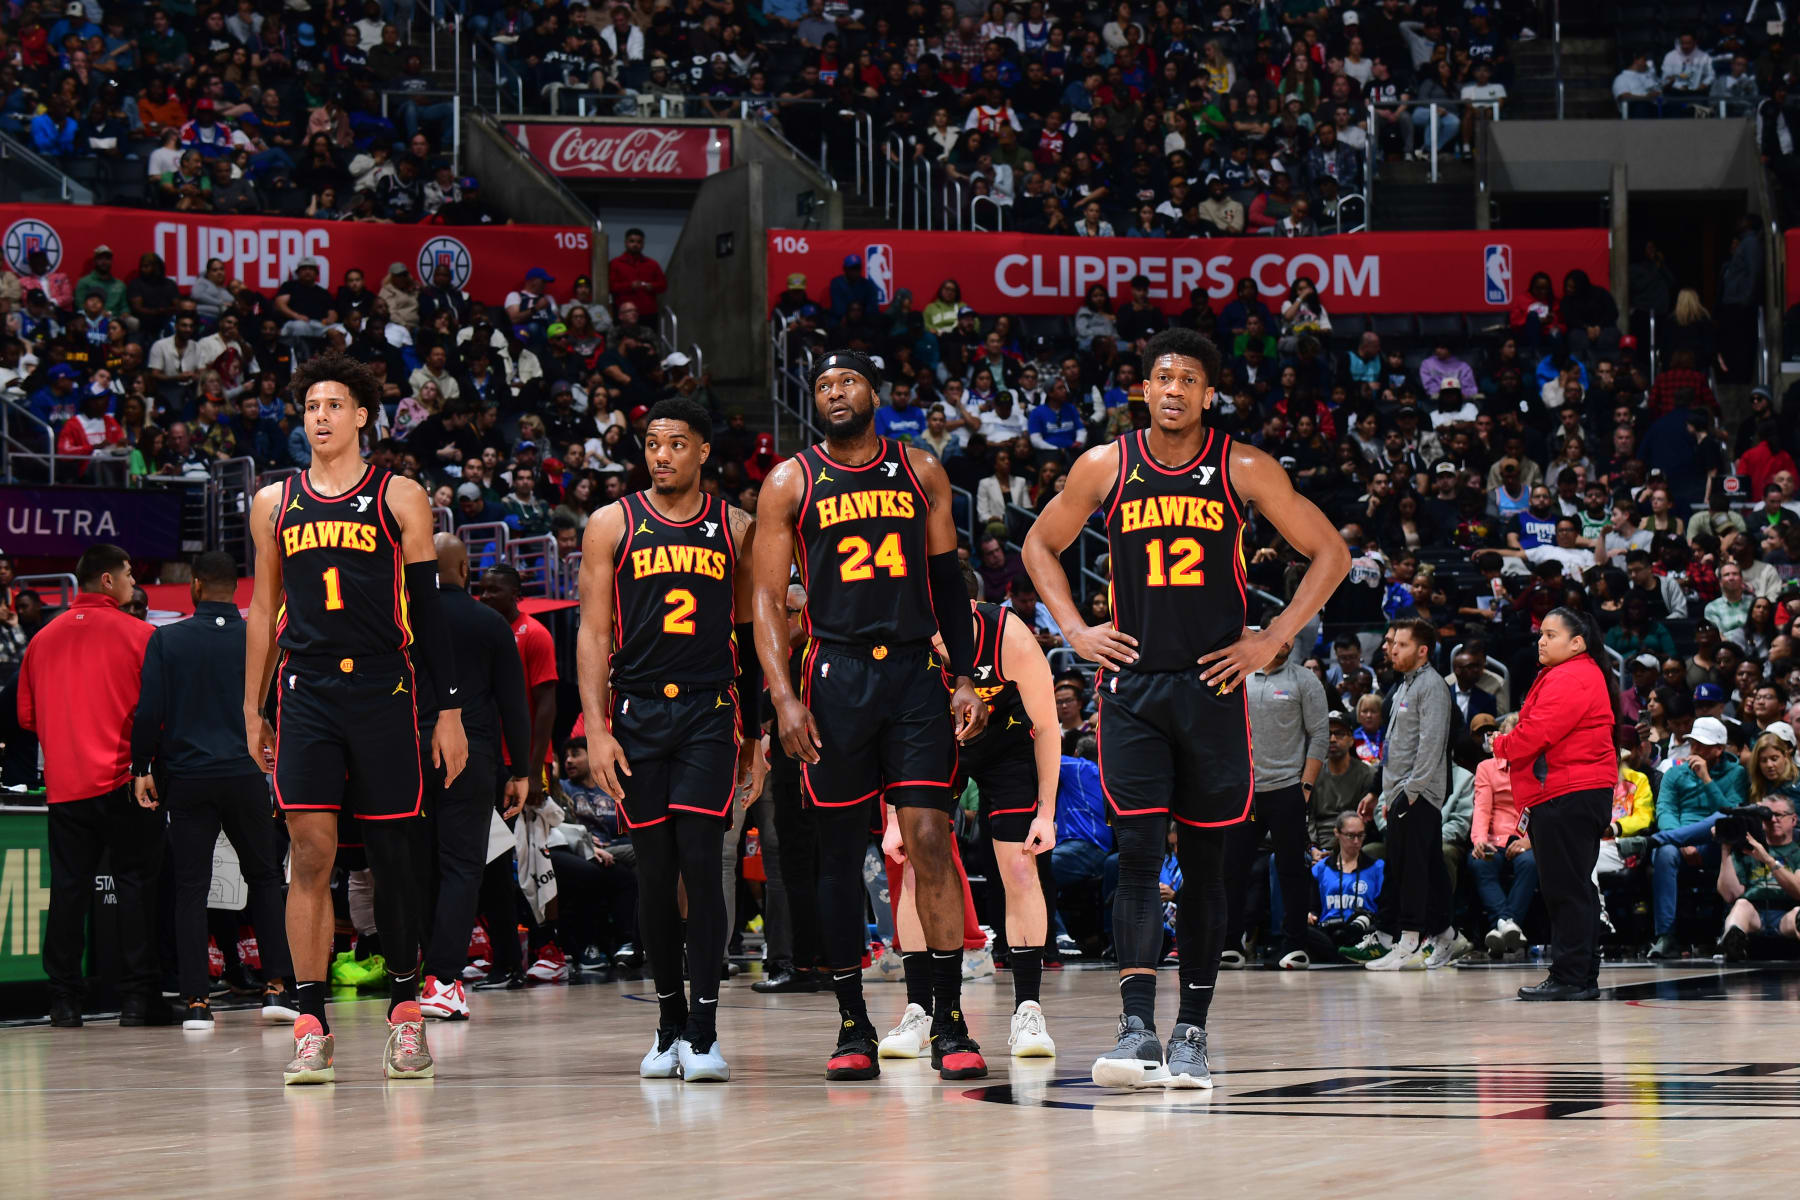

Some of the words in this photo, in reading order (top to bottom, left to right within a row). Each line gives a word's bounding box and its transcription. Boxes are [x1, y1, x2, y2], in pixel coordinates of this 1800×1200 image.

[549, 127, 687, 173] Coca-Cola
[154, 222, 330, 290] CLIPPERS
[554, 232, 589, 249] 105
[773, 236, 809, 254] 106
[994, 253, 1380, 299] CLIPPERSCOM
[7, 507, 117, 536] ULTRA
[816, 490, 915, 530] HAWKS
[1121, 495, 1224, 533] HAWKS
[282, 520, 378, 558] HAWKS
[837, 532, 907, 583] 24
[631, 544, 726, 581] HAWKS
[1146, 537, 1205, 587] 12
[322, 566, 344, 611] 1
[663, 588, 697, 635] 2
[1326, 894, 1364, 909] PHOTO
